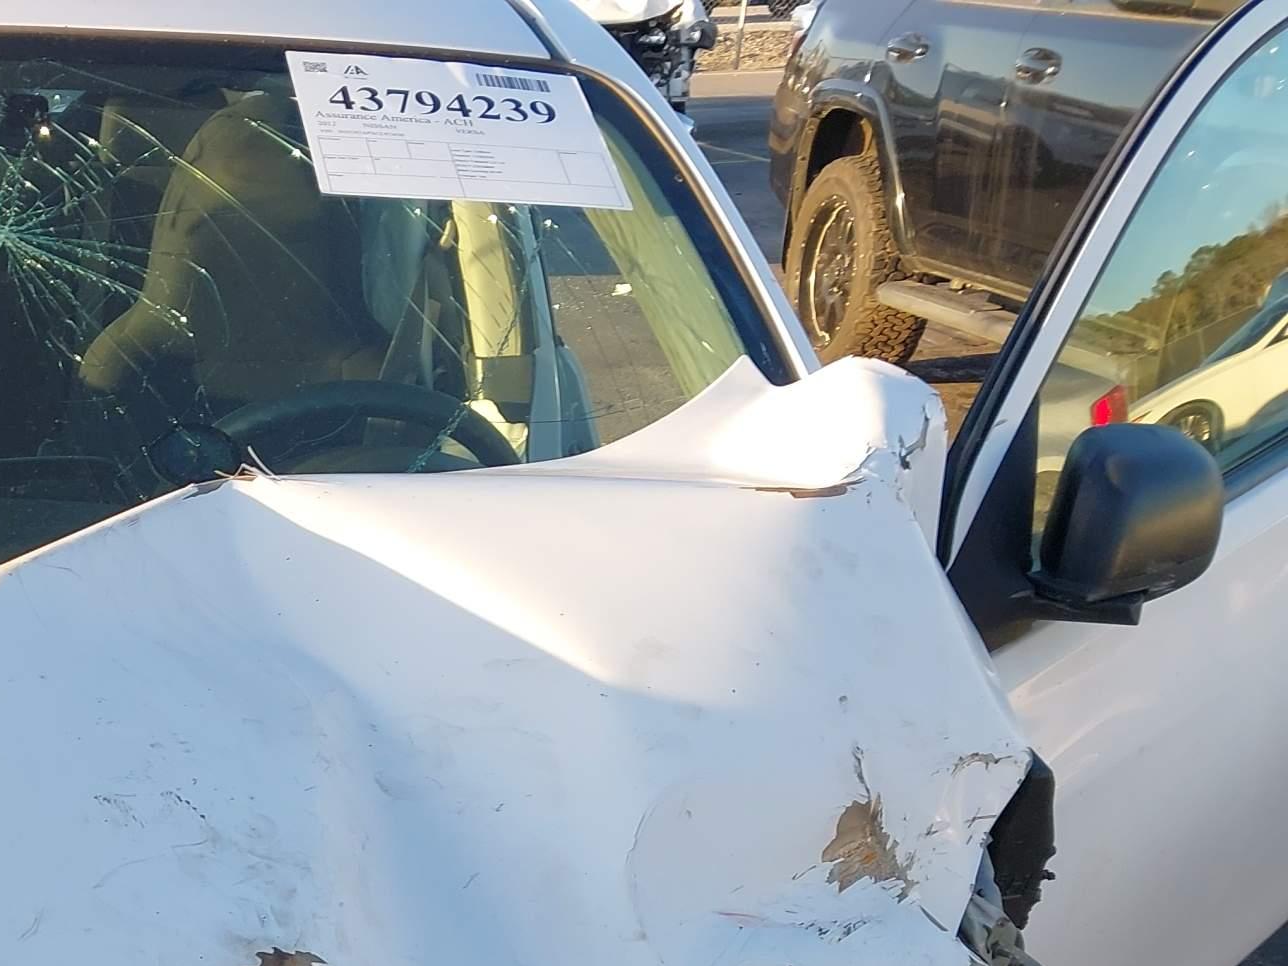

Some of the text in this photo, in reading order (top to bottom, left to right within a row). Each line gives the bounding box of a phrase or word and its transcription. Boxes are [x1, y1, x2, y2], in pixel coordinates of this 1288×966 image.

[315, 110, 377, 121] Assurance
[381, 114, 432, 124] America
[444, 117, 474, 127] ACH
[329, 85, 557, 125] 43794239
